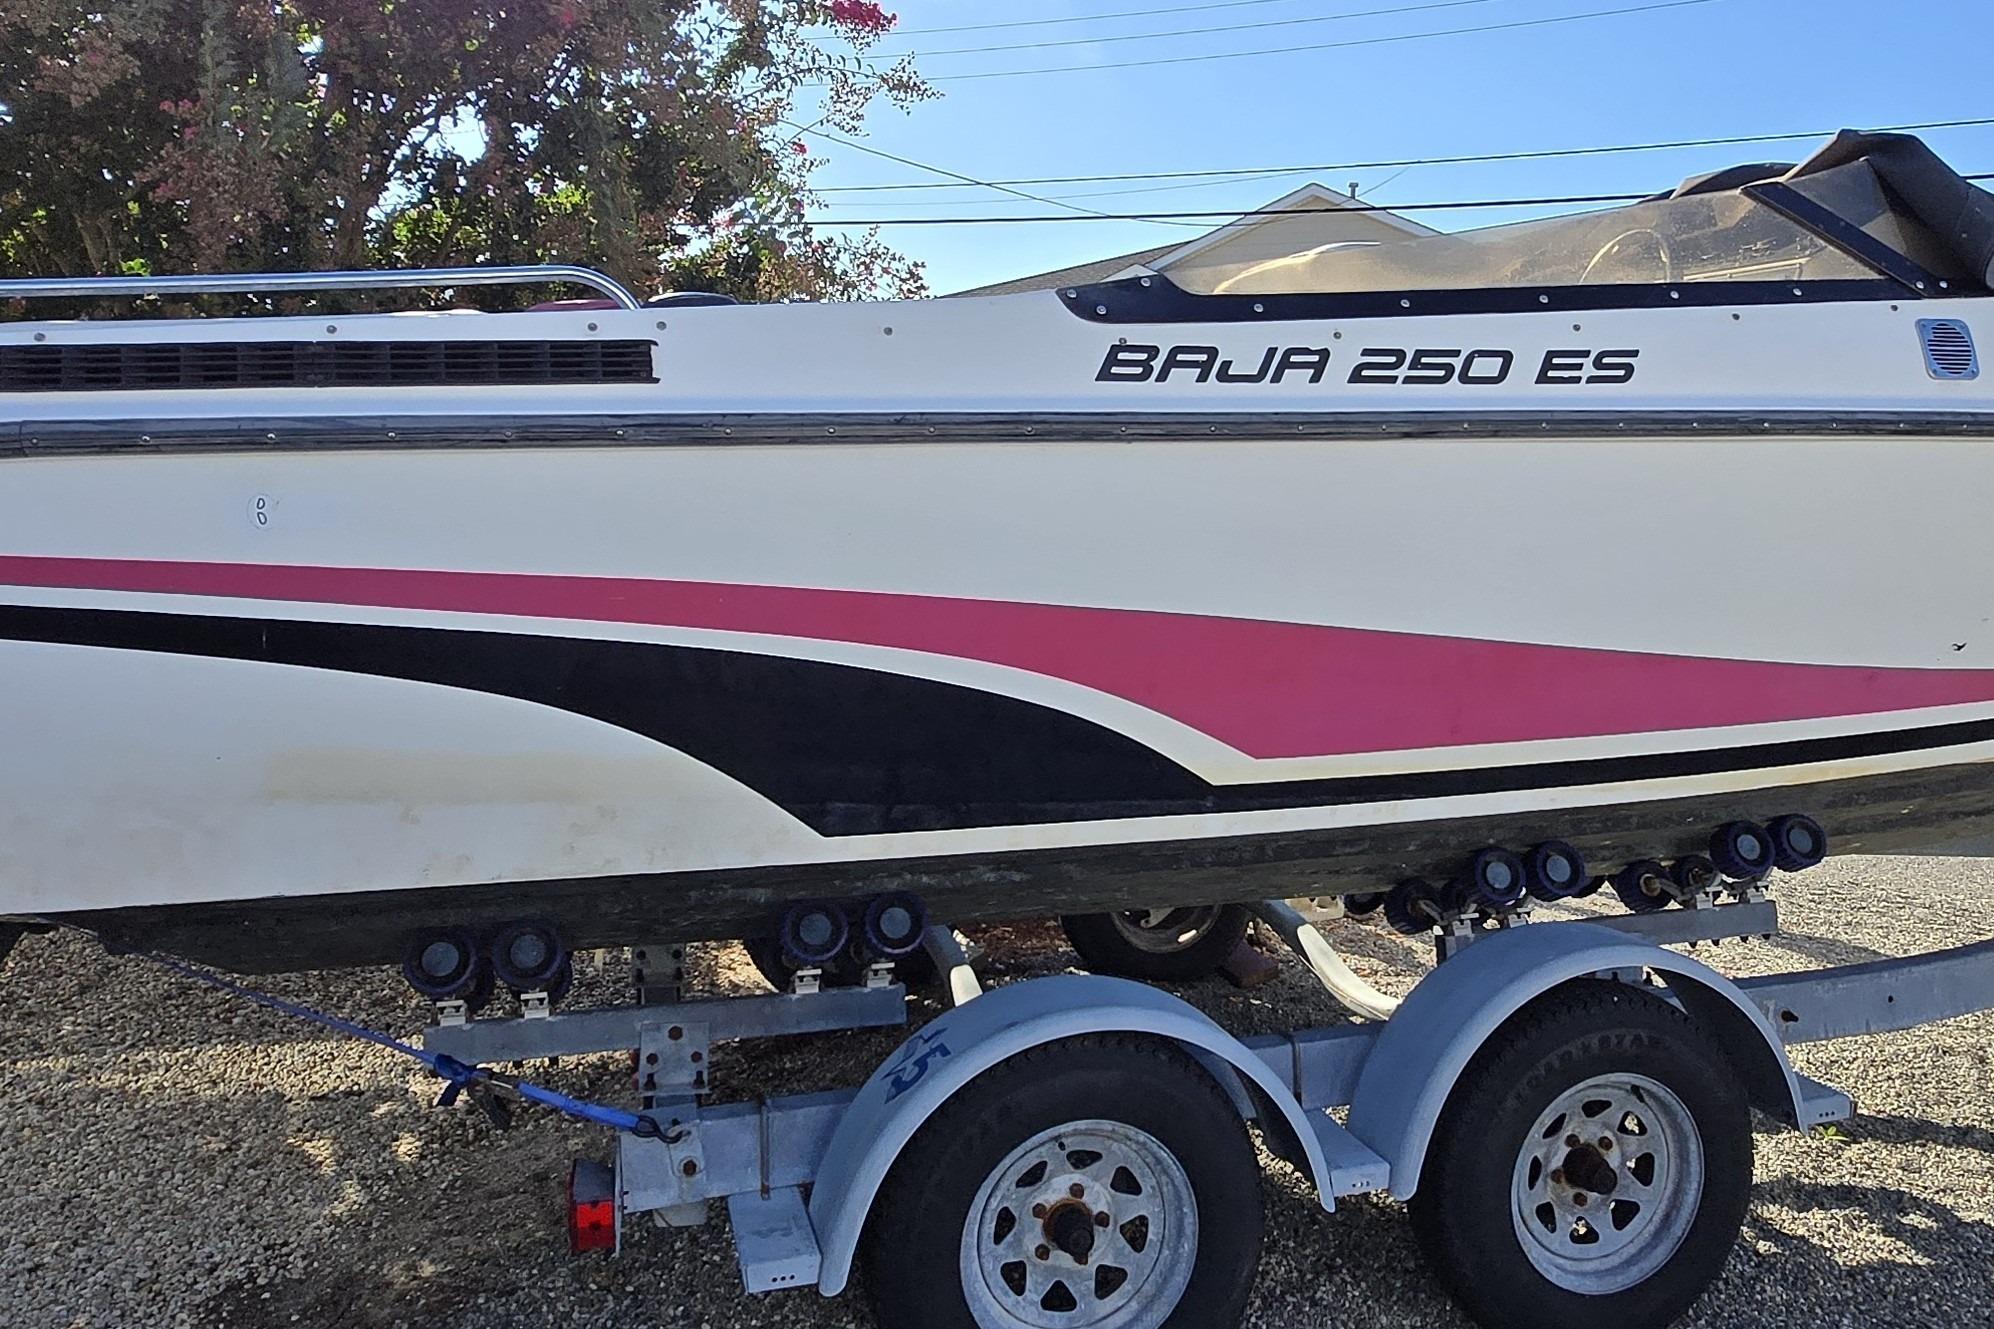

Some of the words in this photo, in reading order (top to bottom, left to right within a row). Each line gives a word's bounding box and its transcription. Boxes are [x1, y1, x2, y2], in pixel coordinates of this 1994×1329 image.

[1095, 344, 1331, 384] BAJA
[1347, 347, 1514, 384] 250
[1534, 348, 1640, 385] ES
